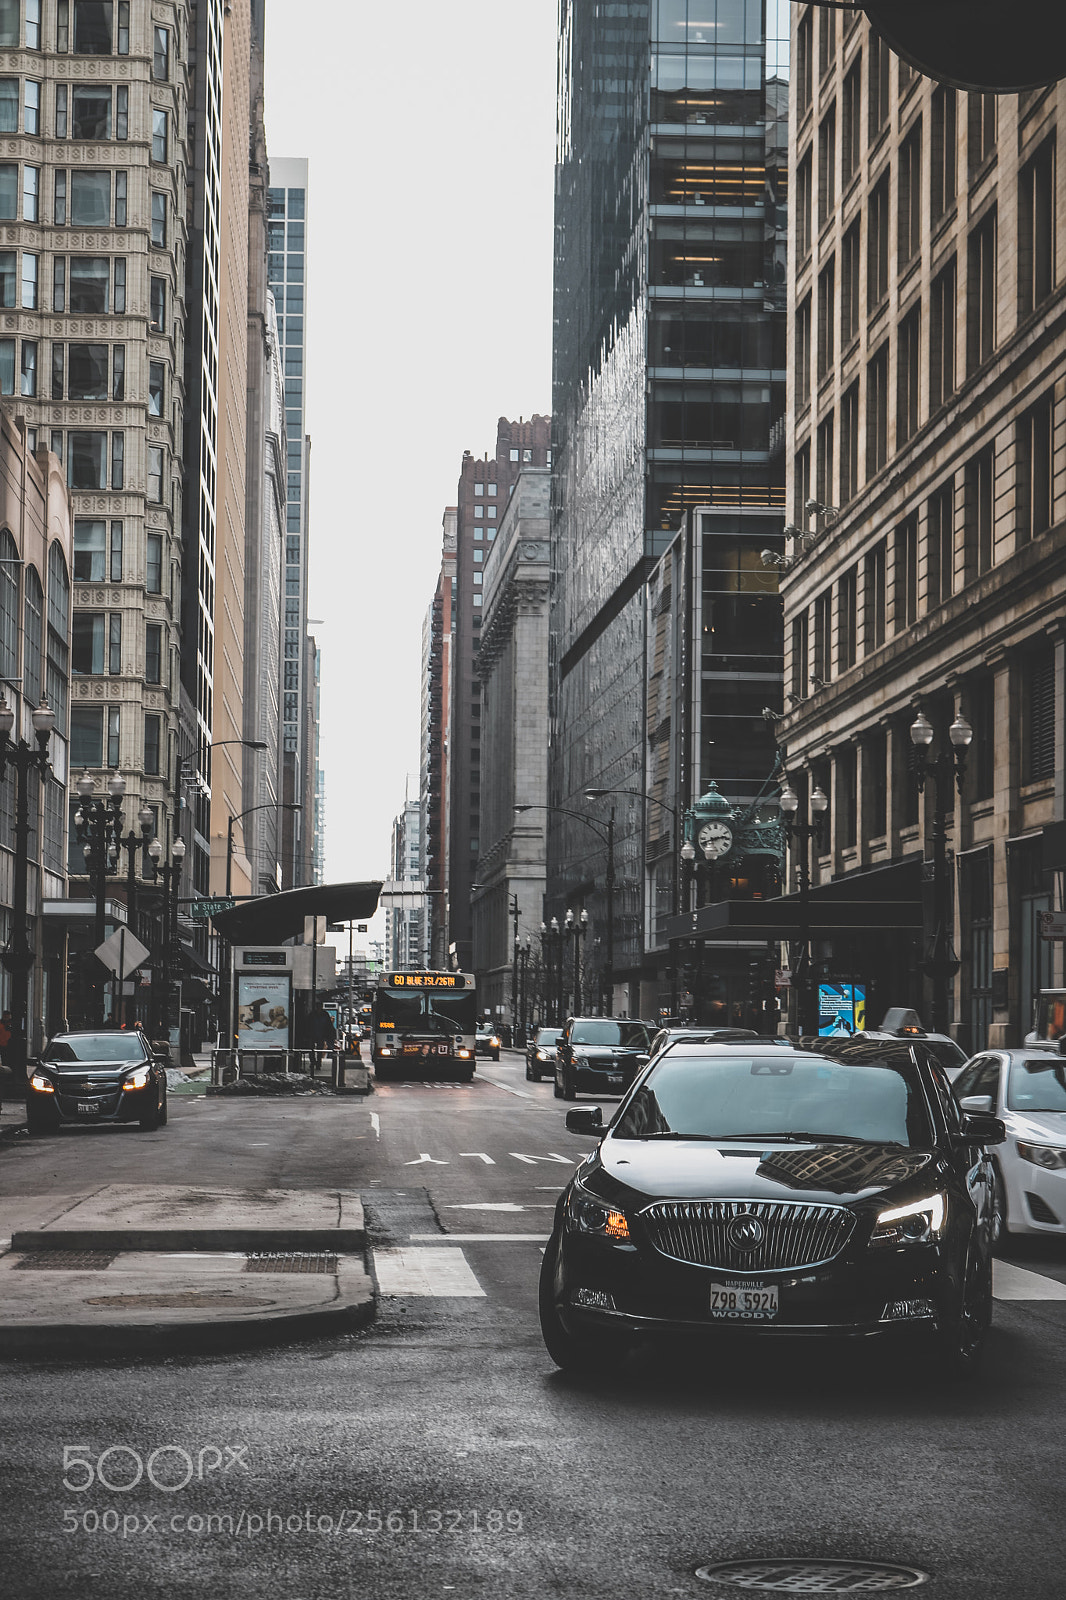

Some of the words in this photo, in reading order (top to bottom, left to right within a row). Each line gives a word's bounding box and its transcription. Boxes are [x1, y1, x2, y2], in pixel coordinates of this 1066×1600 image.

[225, 902, 233, 910] St
[394, 974, 405, 986] 60
[406, 975, 423, 987] BLUE
[403, 1153, 591, 1165] NLY
[725, 1280, 765, 1288] NAPERVILLE
[711, 1291, 737, 1310] Z98
[744, 1292, 778, 1312] 5924
[712, 1311, 776, 1320] WOODY
